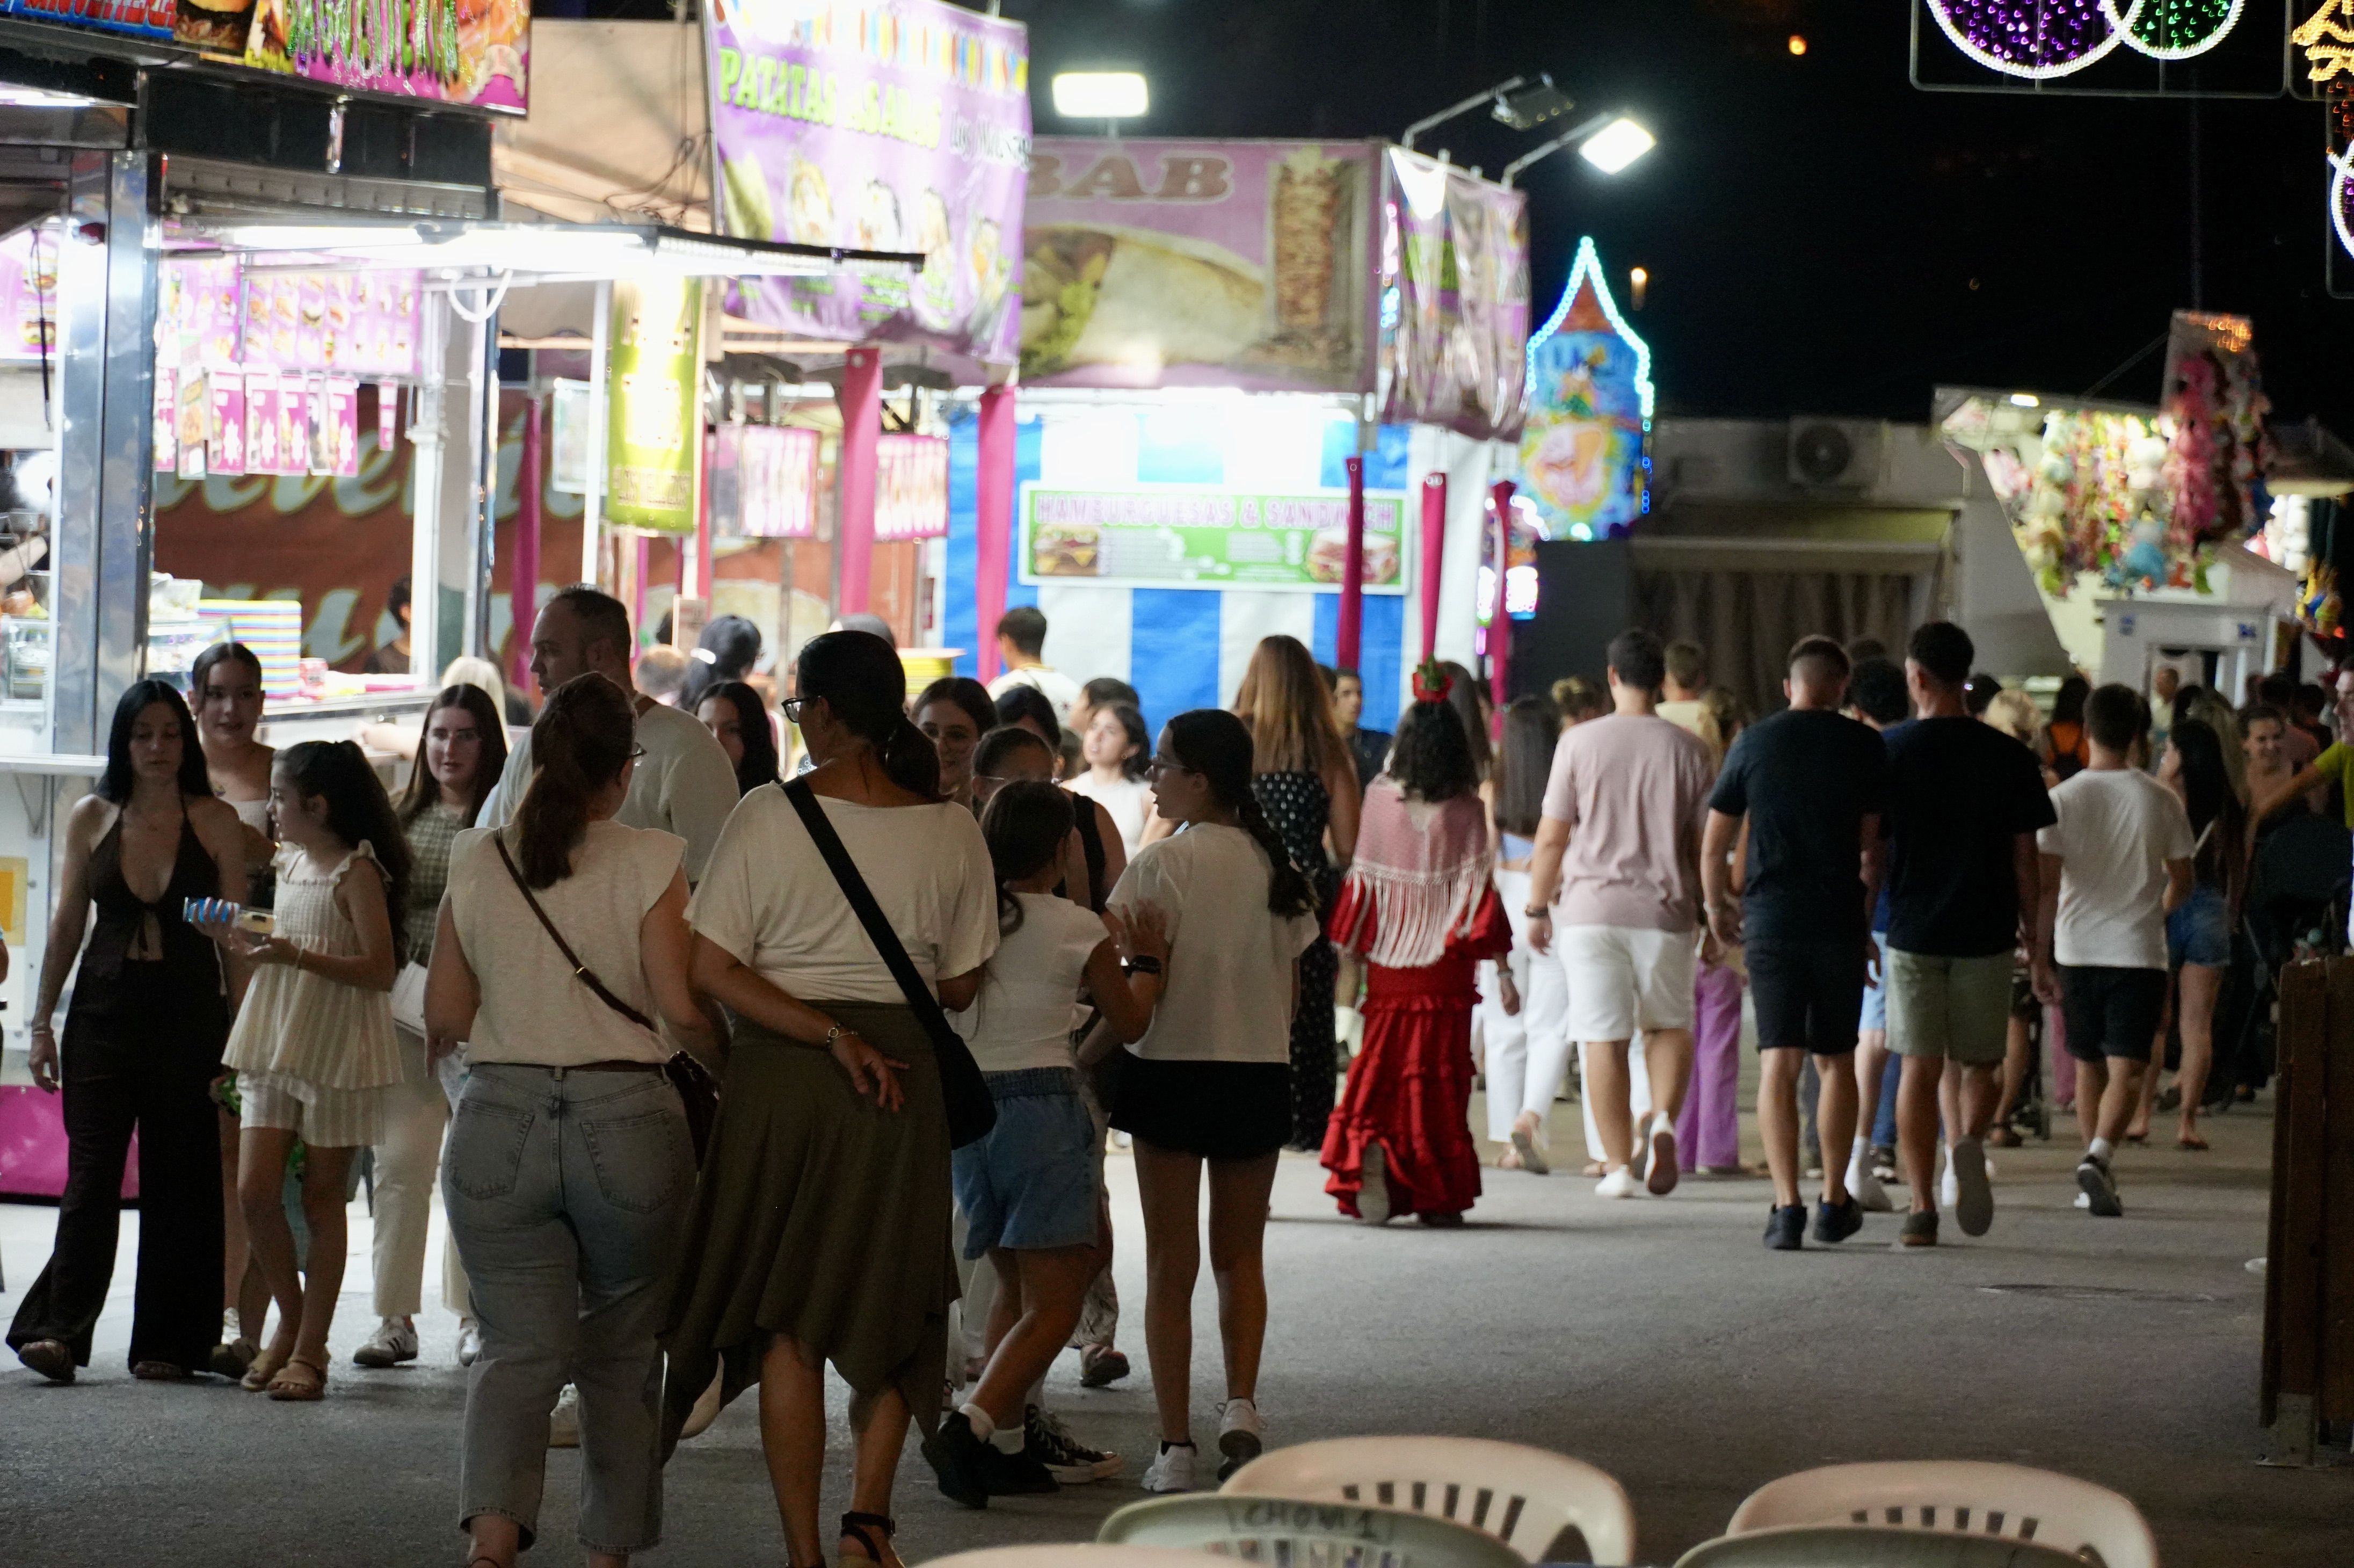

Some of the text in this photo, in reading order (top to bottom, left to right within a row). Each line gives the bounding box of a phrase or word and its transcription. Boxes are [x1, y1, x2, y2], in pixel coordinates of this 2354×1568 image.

[718, 47, 837, 127] PATATAS
[1037, 496, 1395, 531] HAMBURGUESAS & SANDWCH
